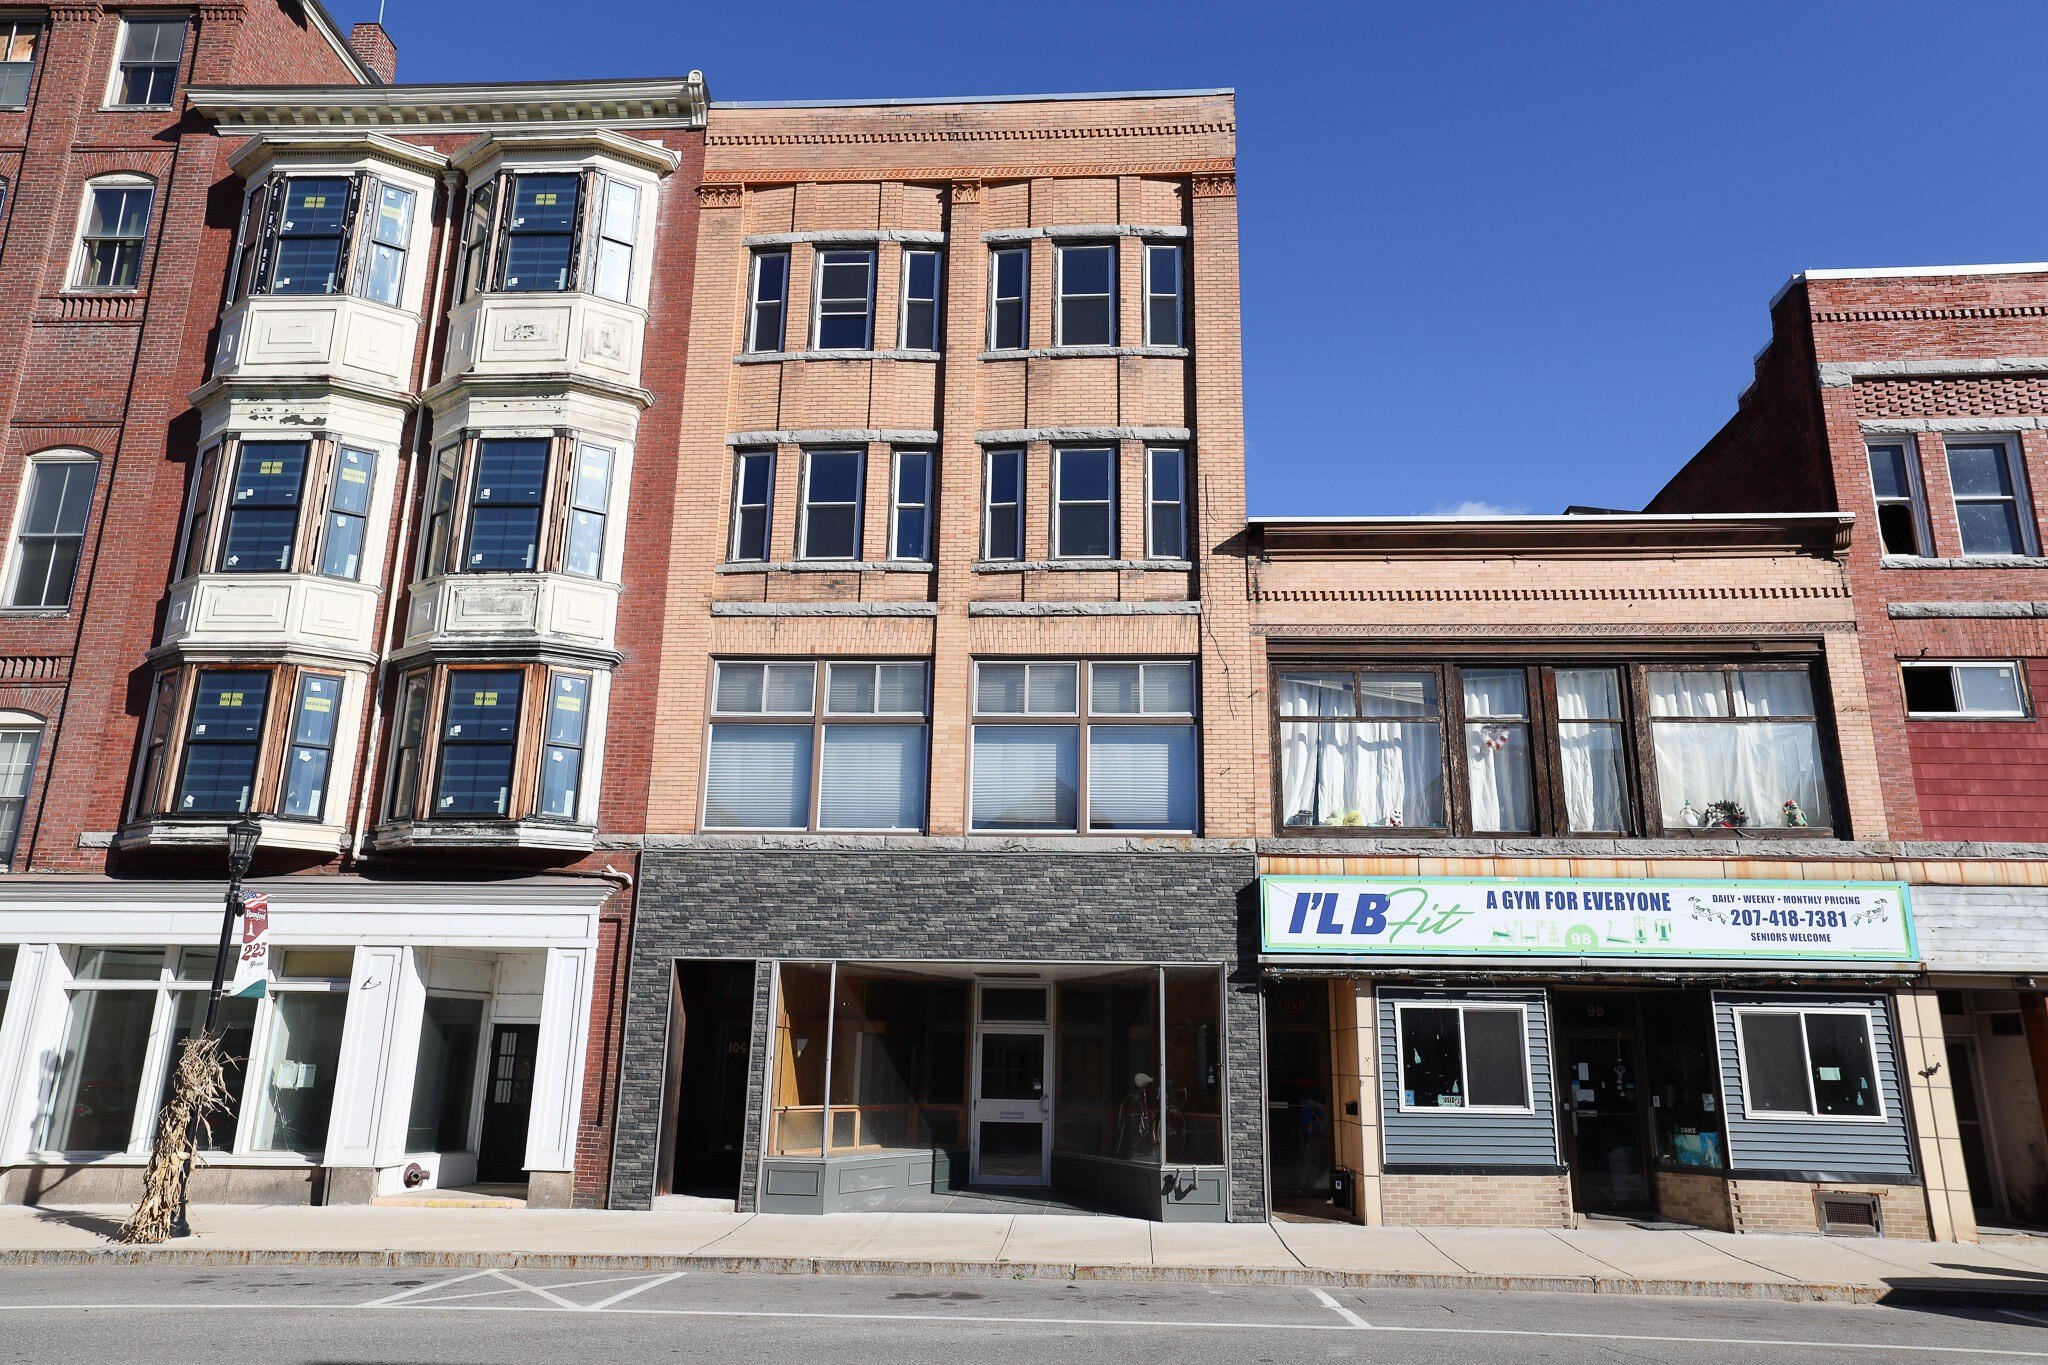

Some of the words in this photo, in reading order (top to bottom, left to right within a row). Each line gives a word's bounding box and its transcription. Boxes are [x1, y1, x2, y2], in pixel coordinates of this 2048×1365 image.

[1486, 890, 1498, 910] A
[1502, 890, 1541, 910] GYM
[1545, 891, 1579, 911] FOR
[1583, 891, 1672, 912] EVERYONE
[1712, 894, 1736, 904] DAILY
[1743, 894, 1776, 905] WEEKLY
[1783, 895, 1823, 905] MONTHLY
[1824, 896, 1861, 906] PRICING
[1350, 893, 1391, 935] B
[1384, 887, 1476, 944] Fit
[1730, 909, 1848, 928] 207-418-7381
[1570, 932, 1593, 945] 98
[1751, 932, 1789, 943] SENIORS
[1789, 933, 1832, 943] WELCOME
[241, 942, 266, 961] 225
